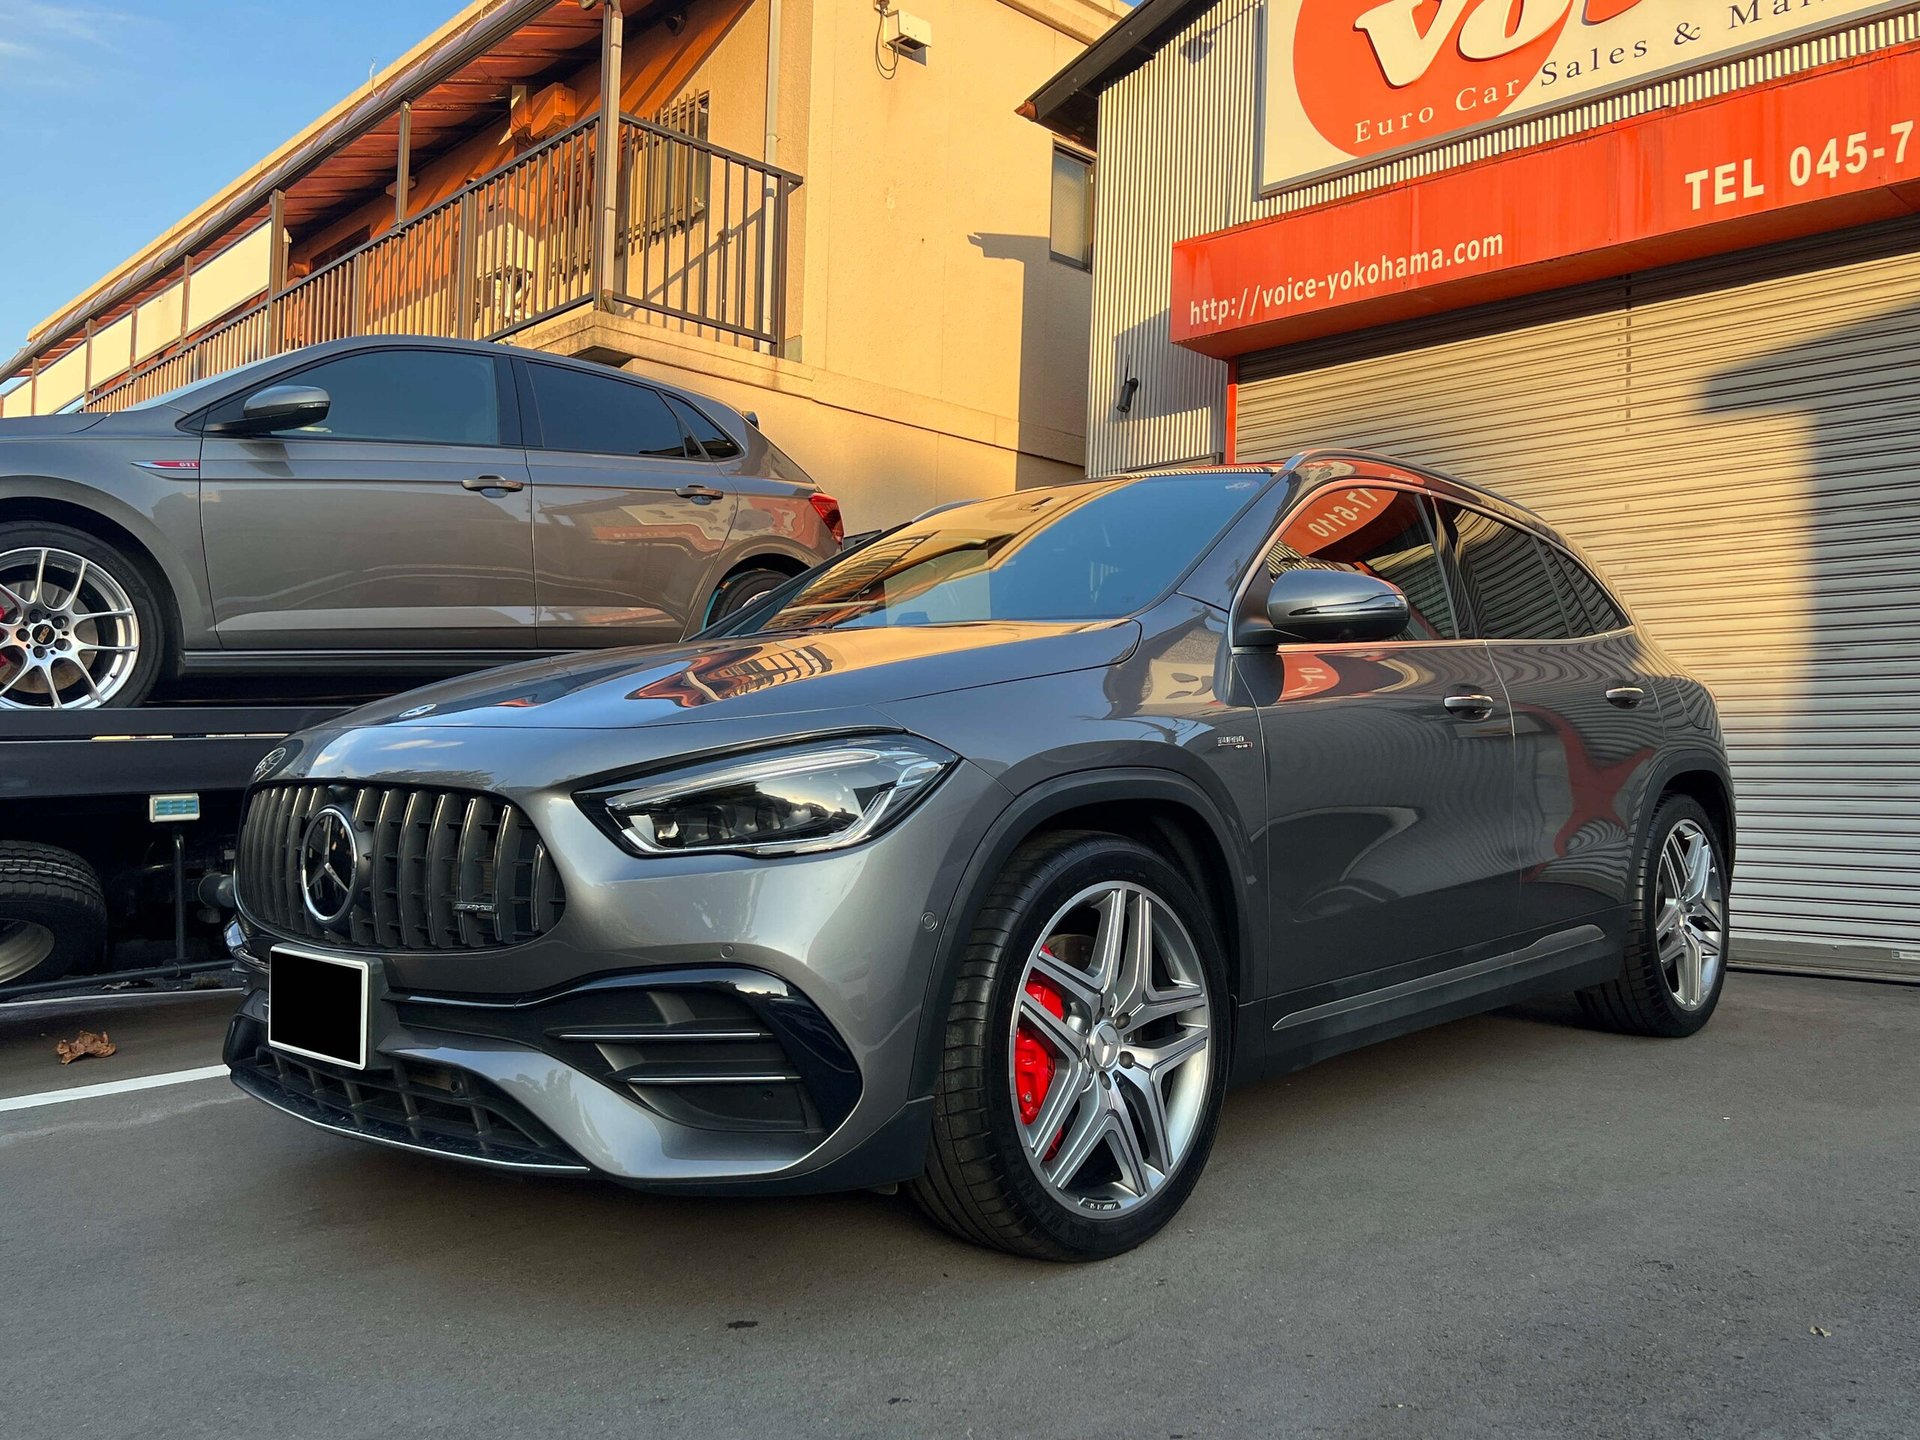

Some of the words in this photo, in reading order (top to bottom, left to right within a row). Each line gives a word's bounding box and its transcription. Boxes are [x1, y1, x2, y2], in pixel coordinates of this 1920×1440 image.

[1353, 105, 1435, 144] Euro
[1455, 78, 1520, 112] Car
[1540, 39, 1648, 87] Sales
[1673, 22, 1701, 46] &
[1684, 157, 1765, 211] TEL
[1788, 119, 1914, 187] 045-7
[1189, 232, 1504, 326] http://voice-yokohama.com
